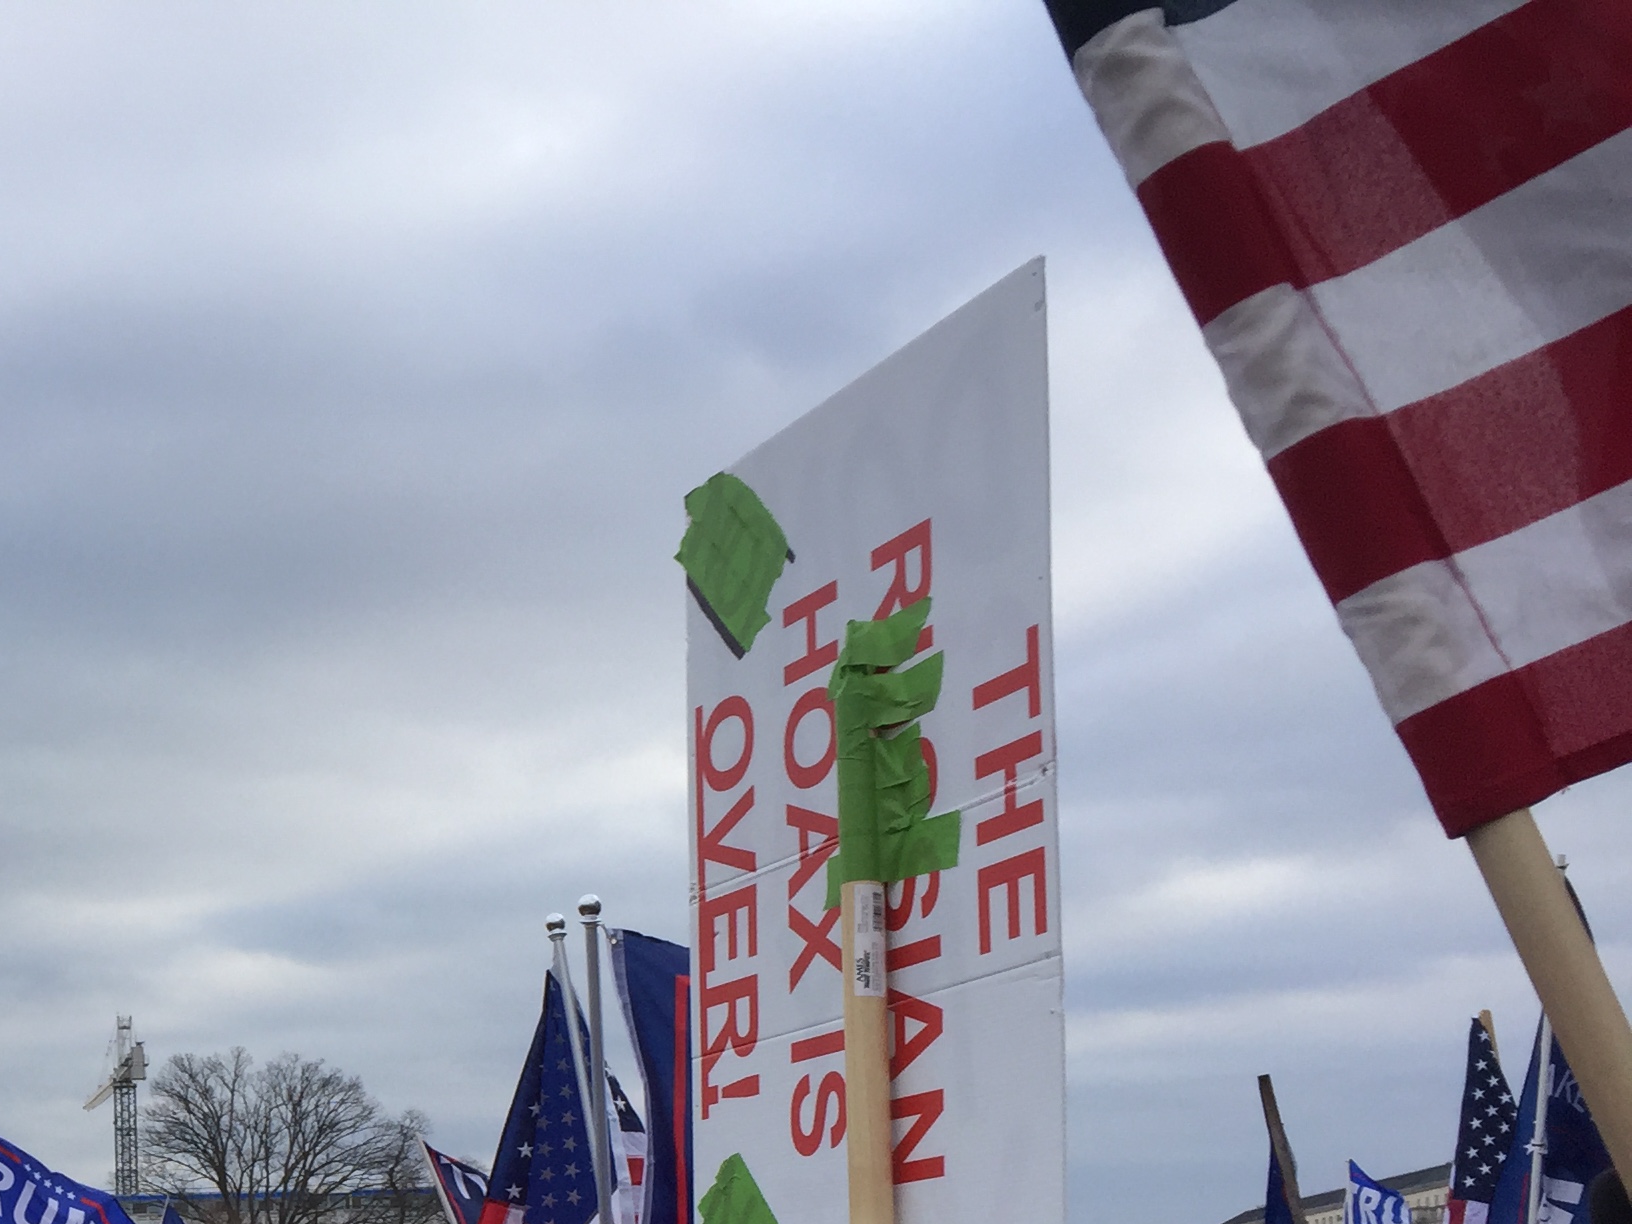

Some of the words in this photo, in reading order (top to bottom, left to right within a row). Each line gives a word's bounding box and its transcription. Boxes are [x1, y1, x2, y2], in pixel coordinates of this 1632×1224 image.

[695, 695, 759, 1121] OVER!
[782, 580, 842, 993] HOAX
[972, 623, 1049, 957] THE
[790, 1027, 846, 1157] IS
